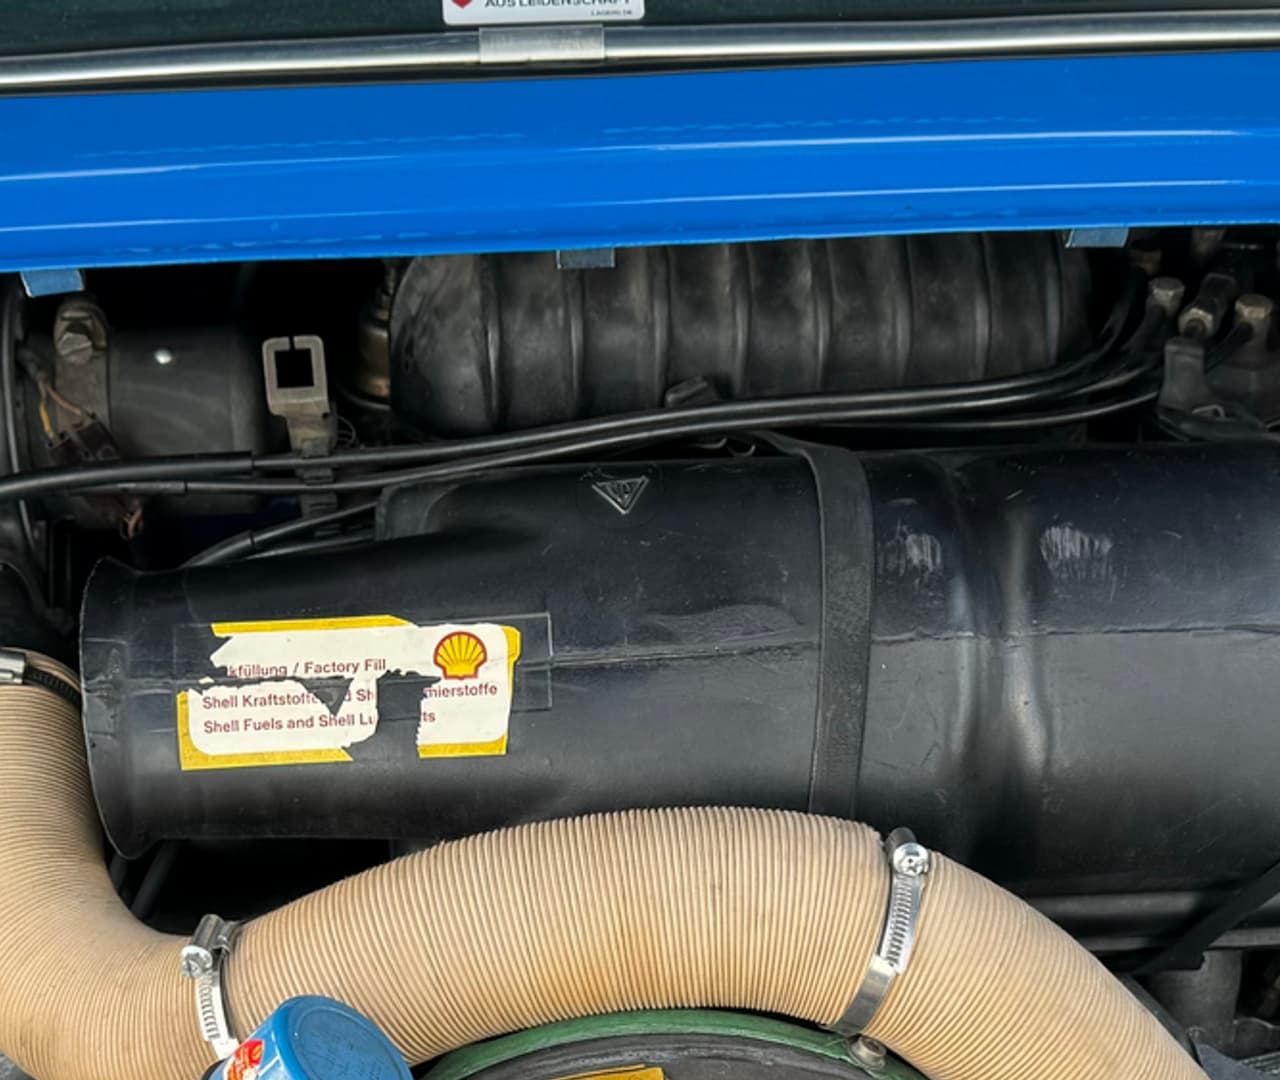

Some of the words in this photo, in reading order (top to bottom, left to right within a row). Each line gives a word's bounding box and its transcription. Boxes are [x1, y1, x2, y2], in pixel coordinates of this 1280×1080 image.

[293, 662, 299, 676] /
[304, 661, 359, 675] Factory
[365, 658, 386, 672] Fill
[202, 695, 238, 709] Shell
[423, 682, 497, 698] mierstoffe
[204, 718, 239, 734] Shell
[244, 717, 283, 731] Fuels
[287, 715, 314, 729] and
[319, 713, 355, 727] Shell
[423, 711, 436, 722] ts
